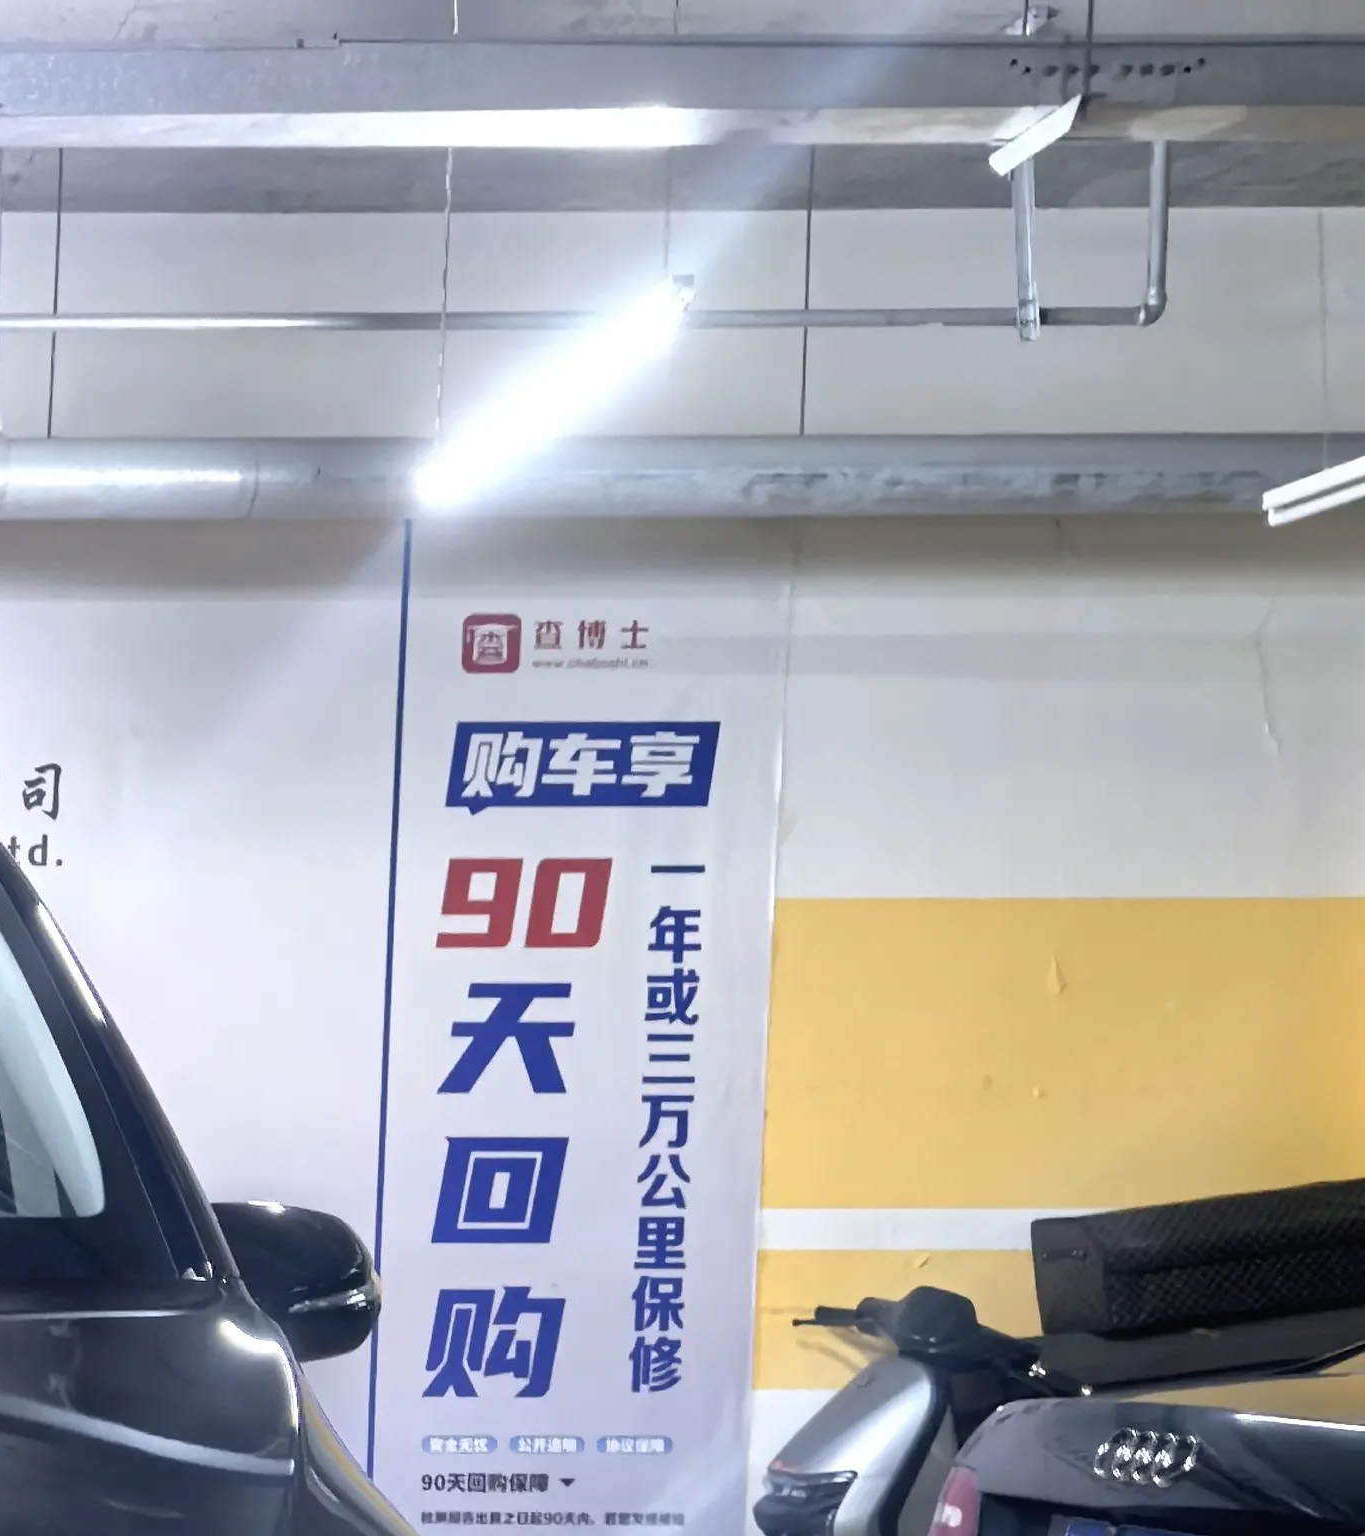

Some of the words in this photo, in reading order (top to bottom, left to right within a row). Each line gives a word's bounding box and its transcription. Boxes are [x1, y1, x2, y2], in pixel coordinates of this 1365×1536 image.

[534, 619, 650, 649] 查博士
[460, 731, 700, 799] 购车享
[7, 834, 64, 867] td.
[629, 864, 706, 1393] 一年或三万公里保修
